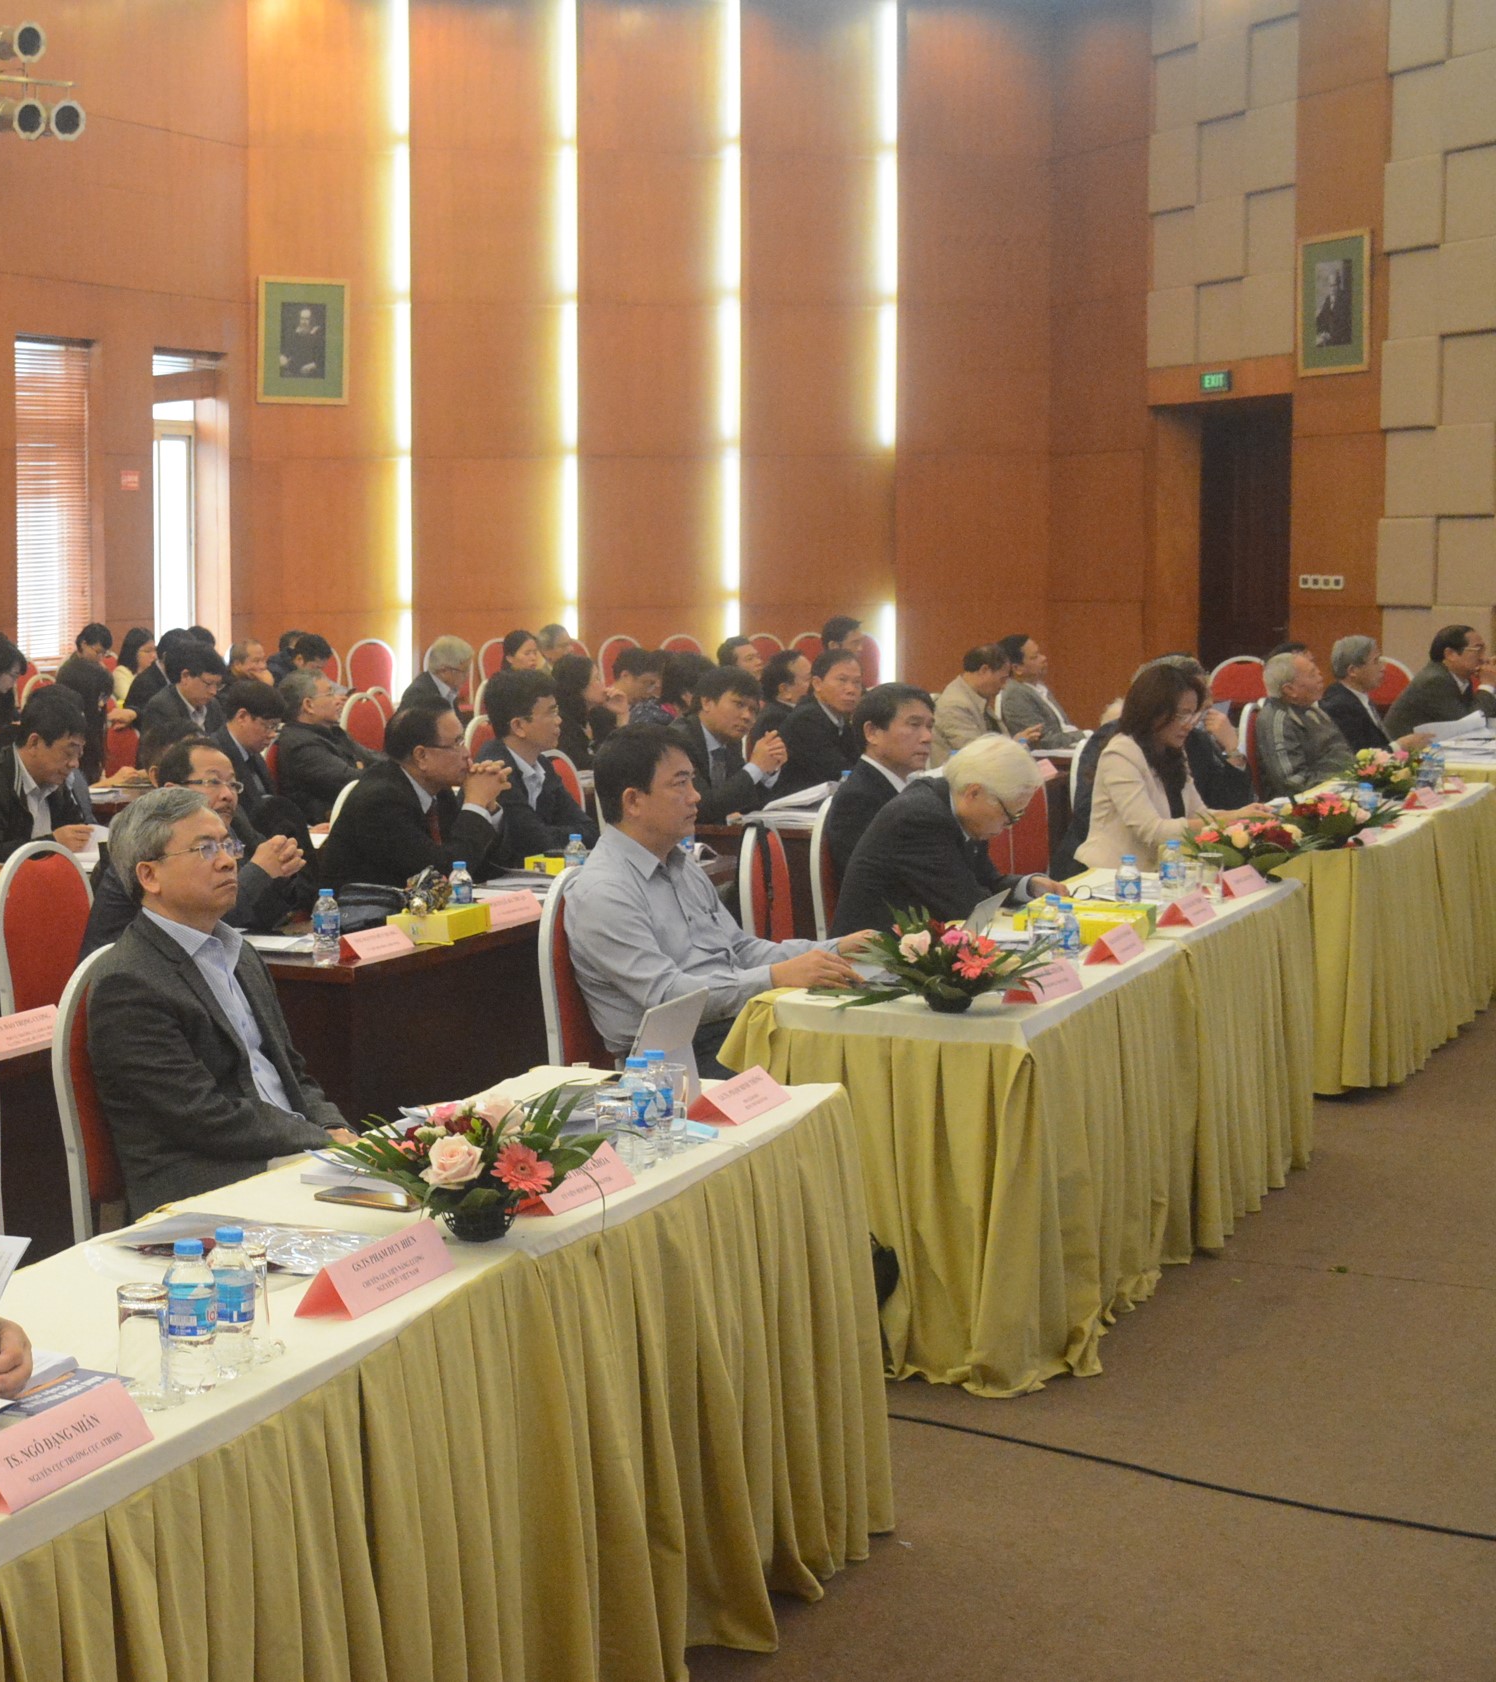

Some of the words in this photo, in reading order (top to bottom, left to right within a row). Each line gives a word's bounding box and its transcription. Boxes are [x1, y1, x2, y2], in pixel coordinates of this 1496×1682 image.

[1204, 373, 1224, 388] EXIT
[387, 1242, 402, 1255] DUY
[4, 1453, 23, 1469] TS.
[20, 1438, 45, 1461] NGÔ
